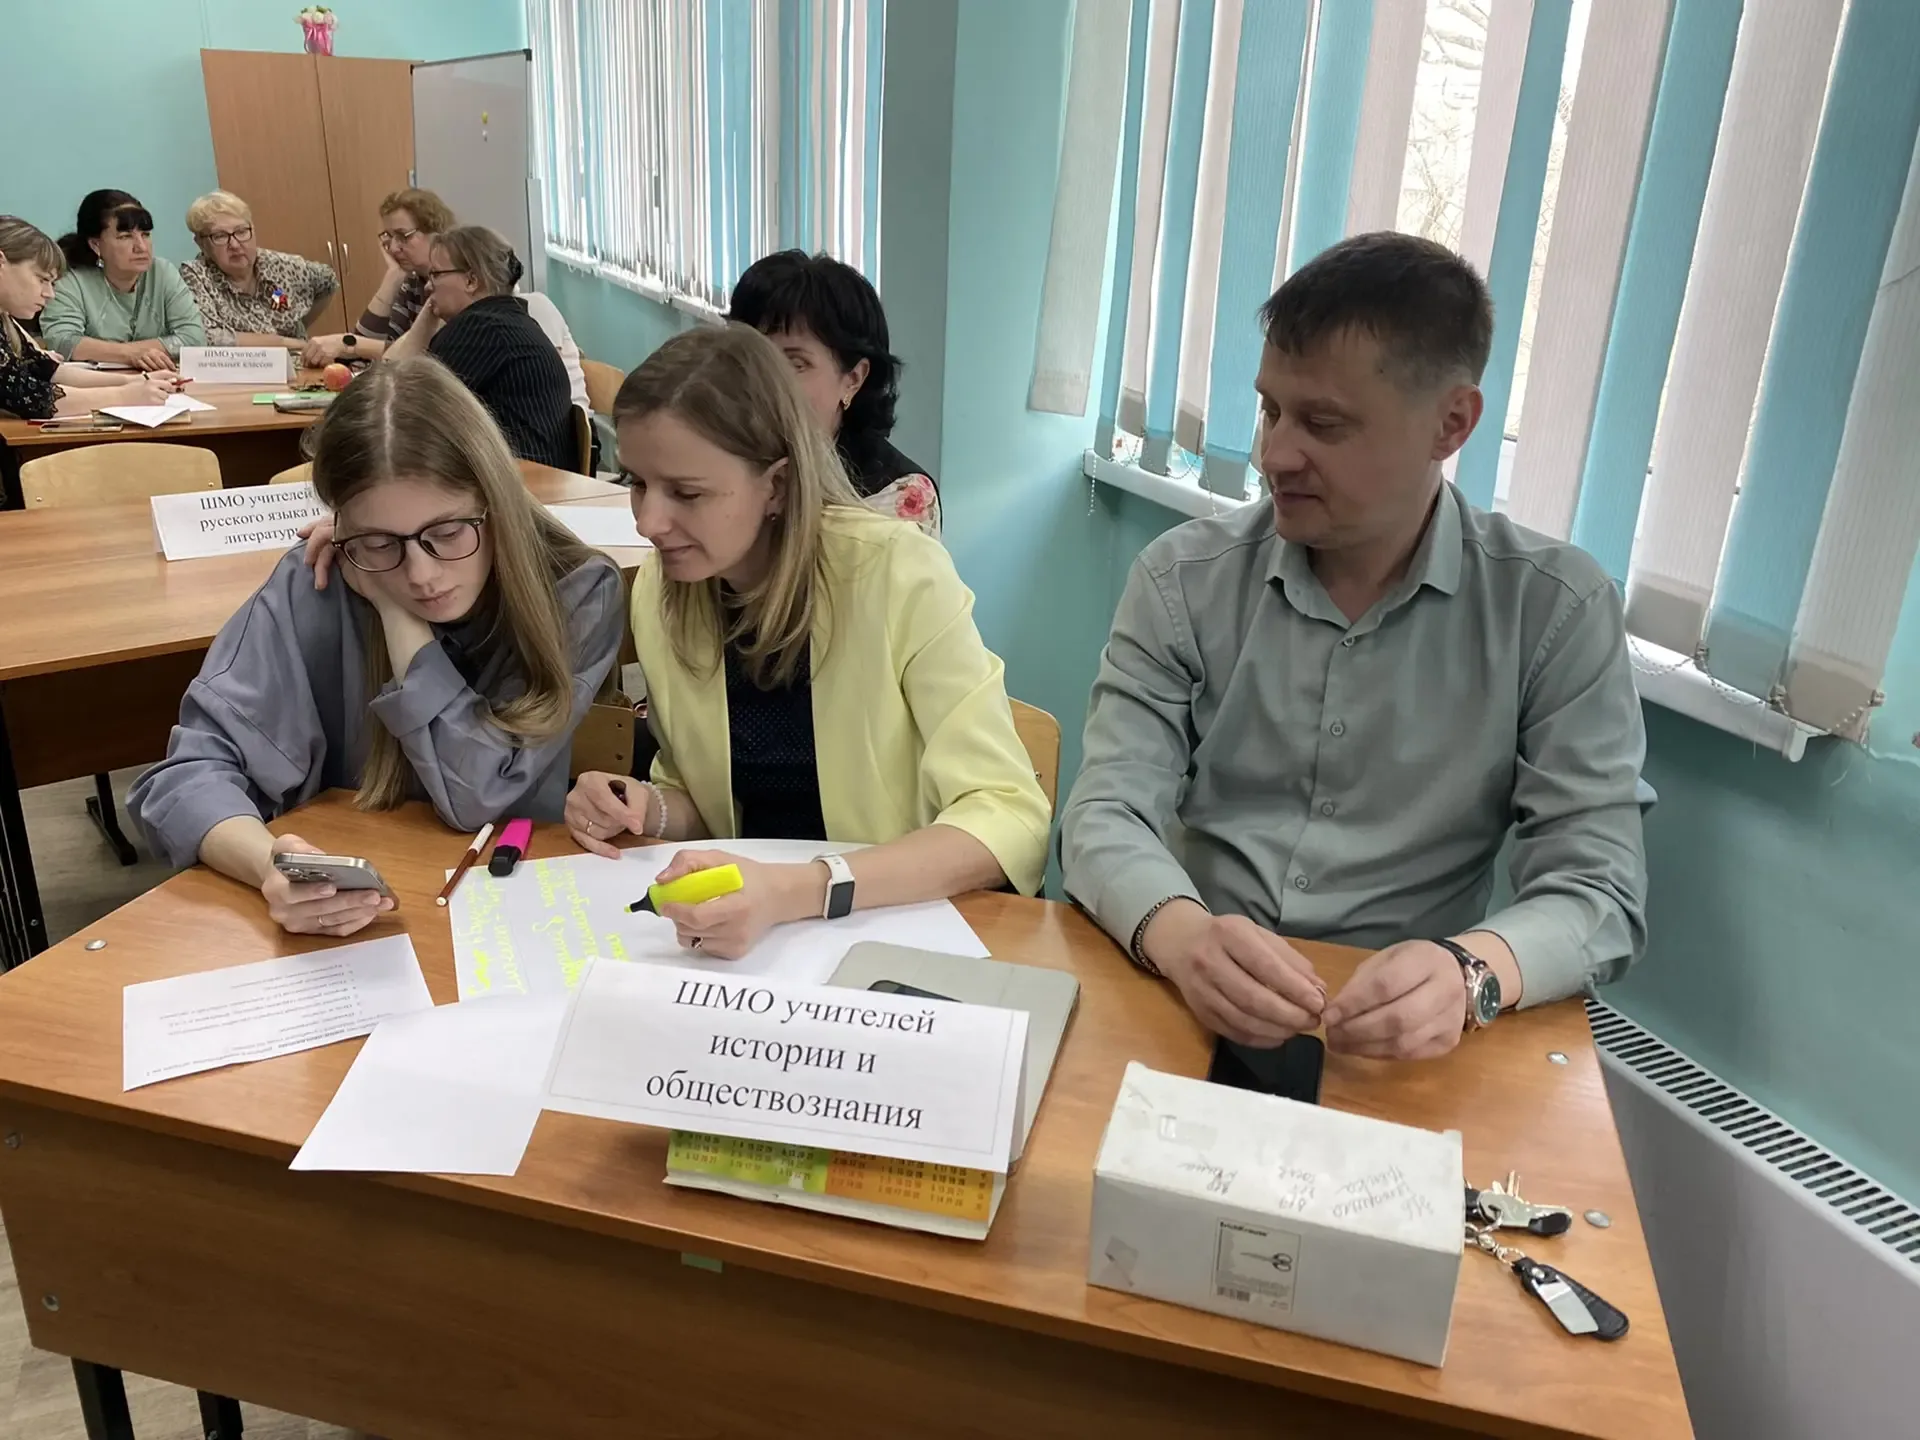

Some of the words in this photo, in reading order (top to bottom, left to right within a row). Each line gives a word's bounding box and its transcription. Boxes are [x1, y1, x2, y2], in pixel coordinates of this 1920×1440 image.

[204, 350, 229, 358] ШМО
[230, 350, 267, 360] учителей
[199, 494, 245, 511] ШМО
[248, 487, 314, 508] учителей
[199, 513, 264, 532] русского
[267, 508, 308, 521] языка
[311, 507, 321, 516] и
[224, 527, 299, 545] литератур
[672, 979, 774, 1015] ШМО
[779, 998, 936, 1036] учителей
[708, 1032, 846, 1073] истории
[855, 1052, 877, 1074] и
[645, 1069, 924, 1130] обществознания
